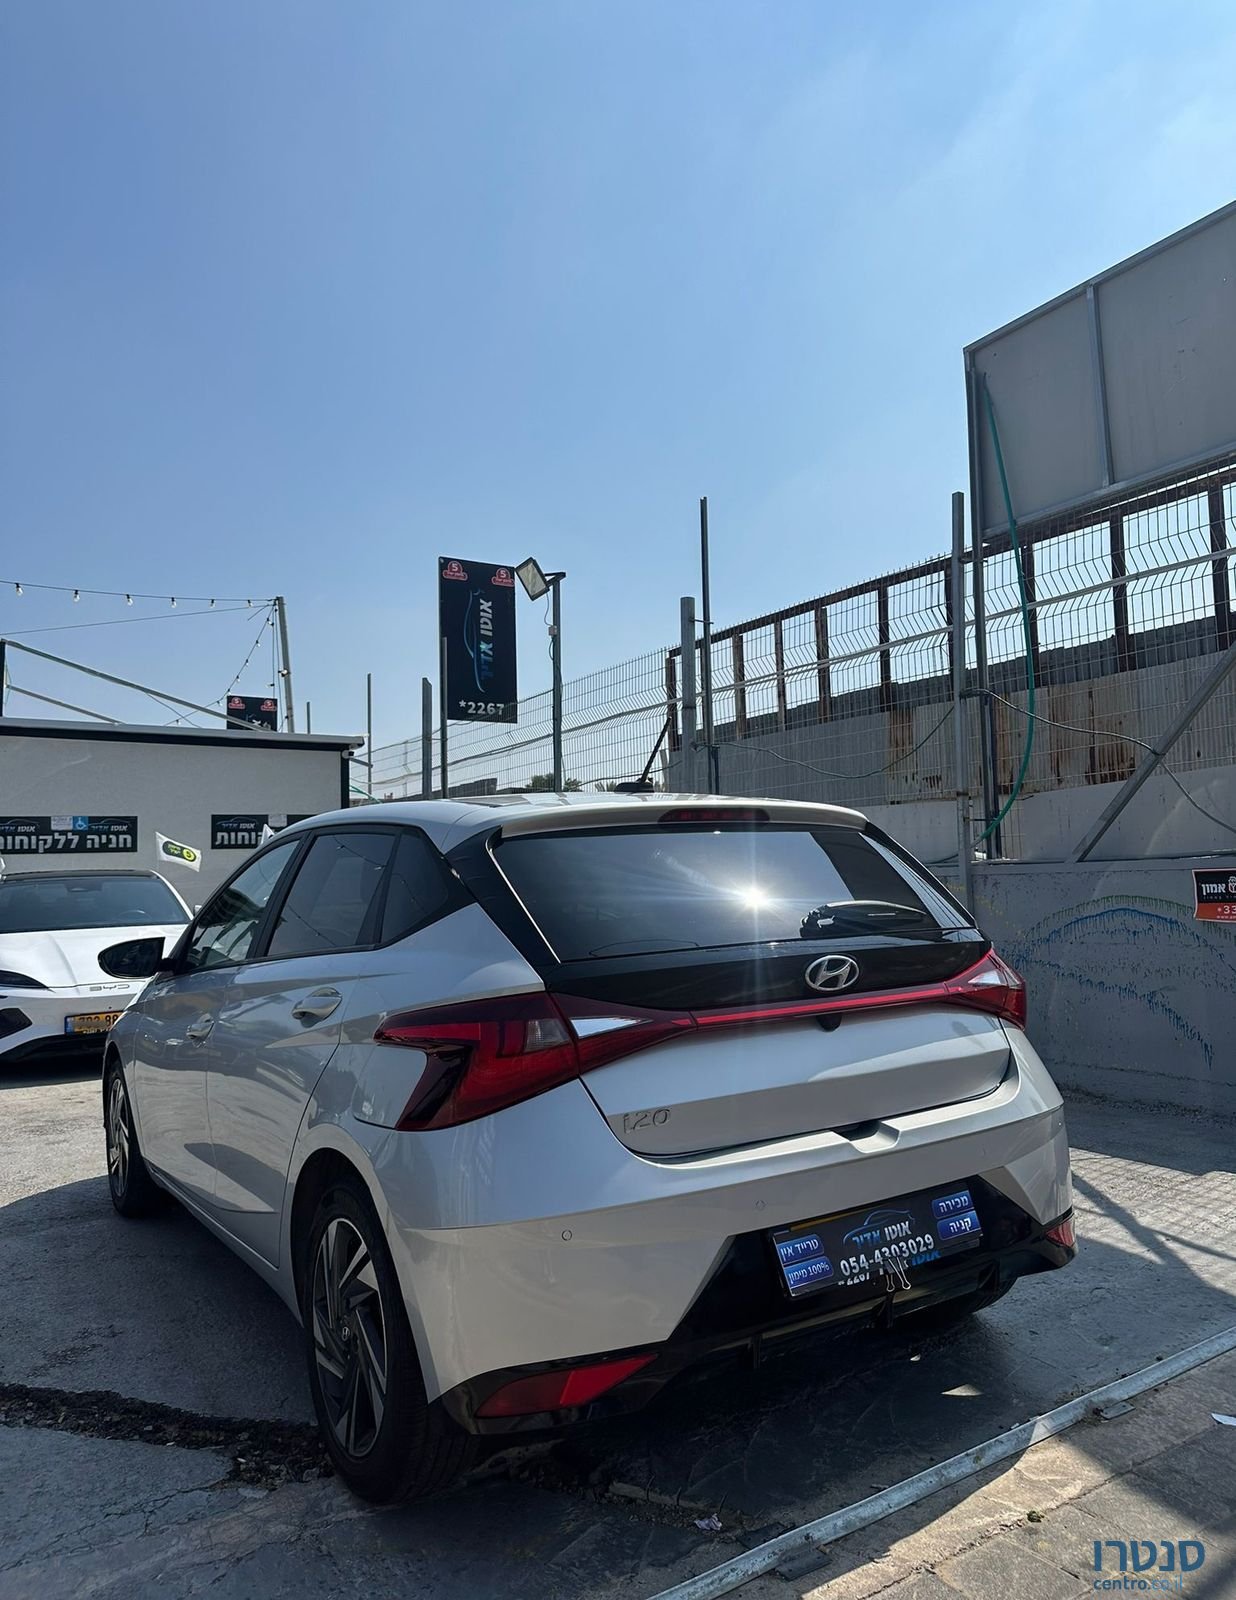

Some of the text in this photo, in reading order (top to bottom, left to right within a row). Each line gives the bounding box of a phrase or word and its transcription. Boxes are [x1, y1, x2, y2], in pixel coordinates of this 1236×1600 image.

[480, 598, 493, 636] אוטו
[86, 834, 132, 849] חניה
[1201, 883, 1226, 896] אמון
[939, 1195, 969, 1213] מכירה
[852, 1221, 912, 1249] אוטו אדיר
[949, 1217, 972, 1233] קניה
[780, 1239, 819, 1262] טרייד אין
[840, 1233, 935, 1276] 054-4303029
[788, 1262, 830, 1284] 100% מימון
